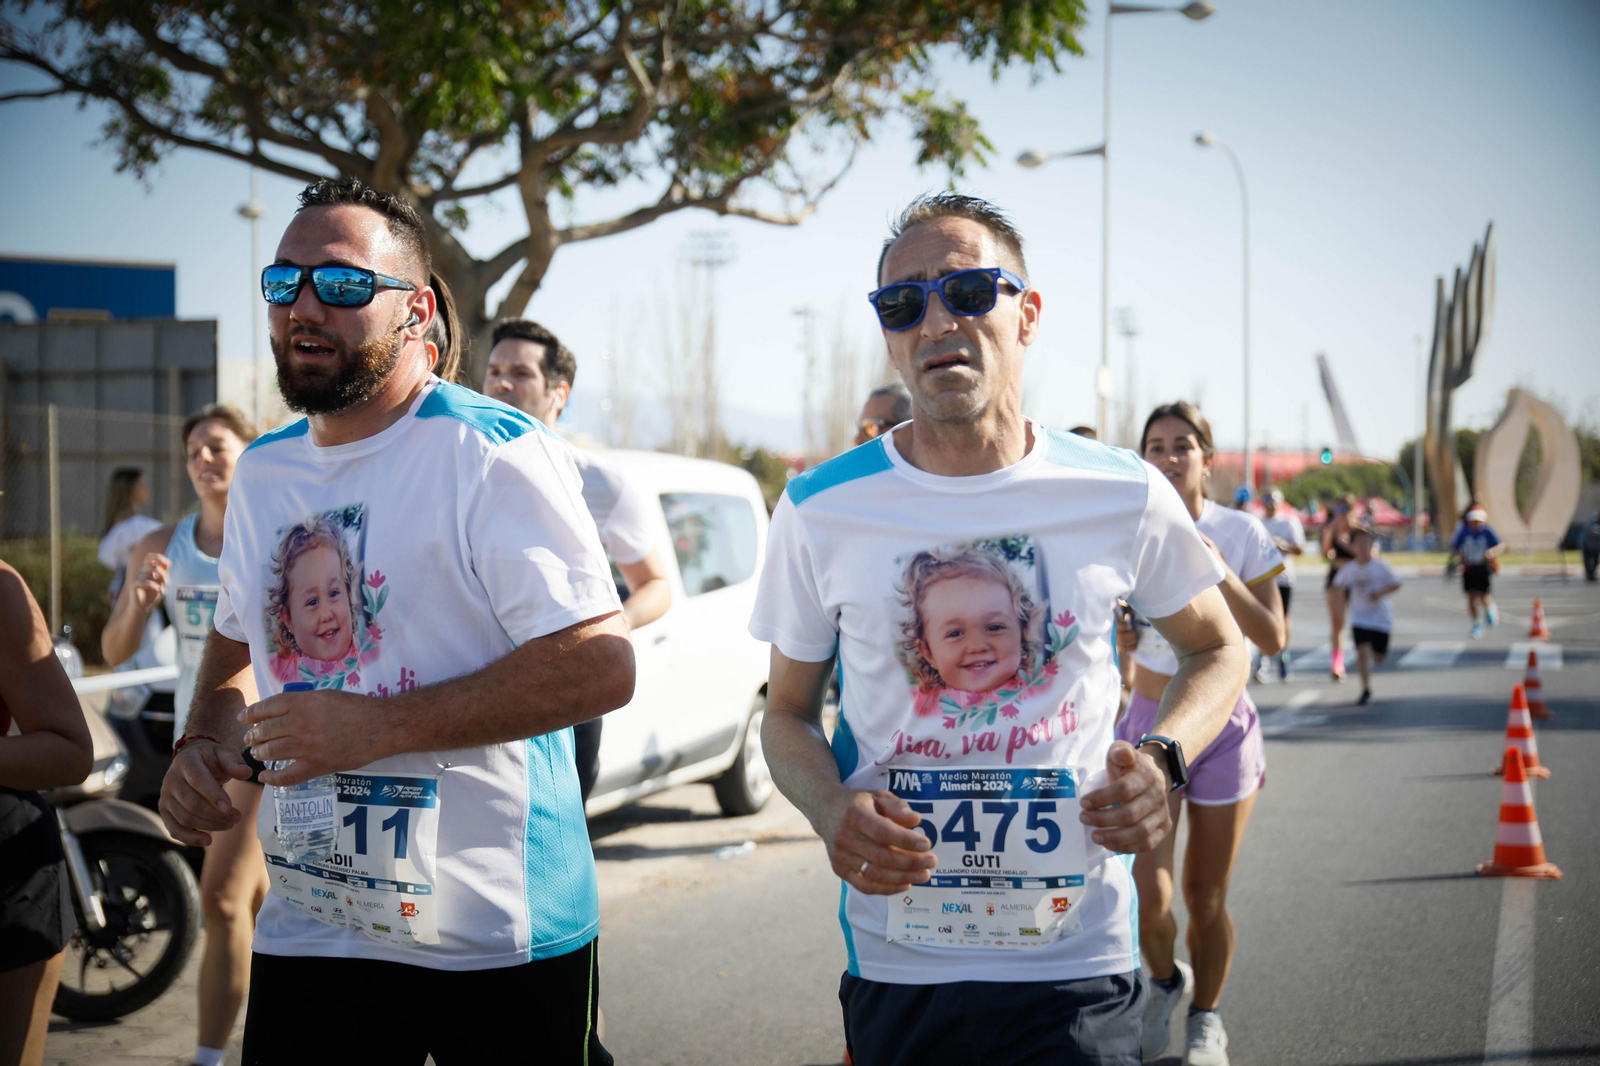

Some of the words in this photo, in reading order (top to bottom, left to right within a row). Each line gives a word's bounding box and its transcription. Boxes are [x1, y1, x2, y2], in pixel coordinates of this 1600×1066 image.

[962, 731, 1001, 755] va
[1006, 717, 1054, 764] por
[1057, 701, 1080, 735] ti
[939, 772, 968, 780] Medio
[971, 772, 1012, 780] Maratón
[343, 785, 372, 796] 2024
[940, 780, 981, 791] Almería
[982, 780, 1012, 791] 2024
[279, 797, 333, 817] SANTOLÍN
[335, 805, 410, 859] 11
[909, 800, 1061, 853] 5475
[962, 854, 1000, 868] GUTI
[330, 865, 351, 874] ASENSIO
[351, 868, 369, 876] PALMA
[311, 887, 338, 899] NEXAL
[356, 900, 385, 910] ALMERÍA
[941, 901, 973, 914] NEXAL
[1000, 903, 1033, 911] ALMERÍA
